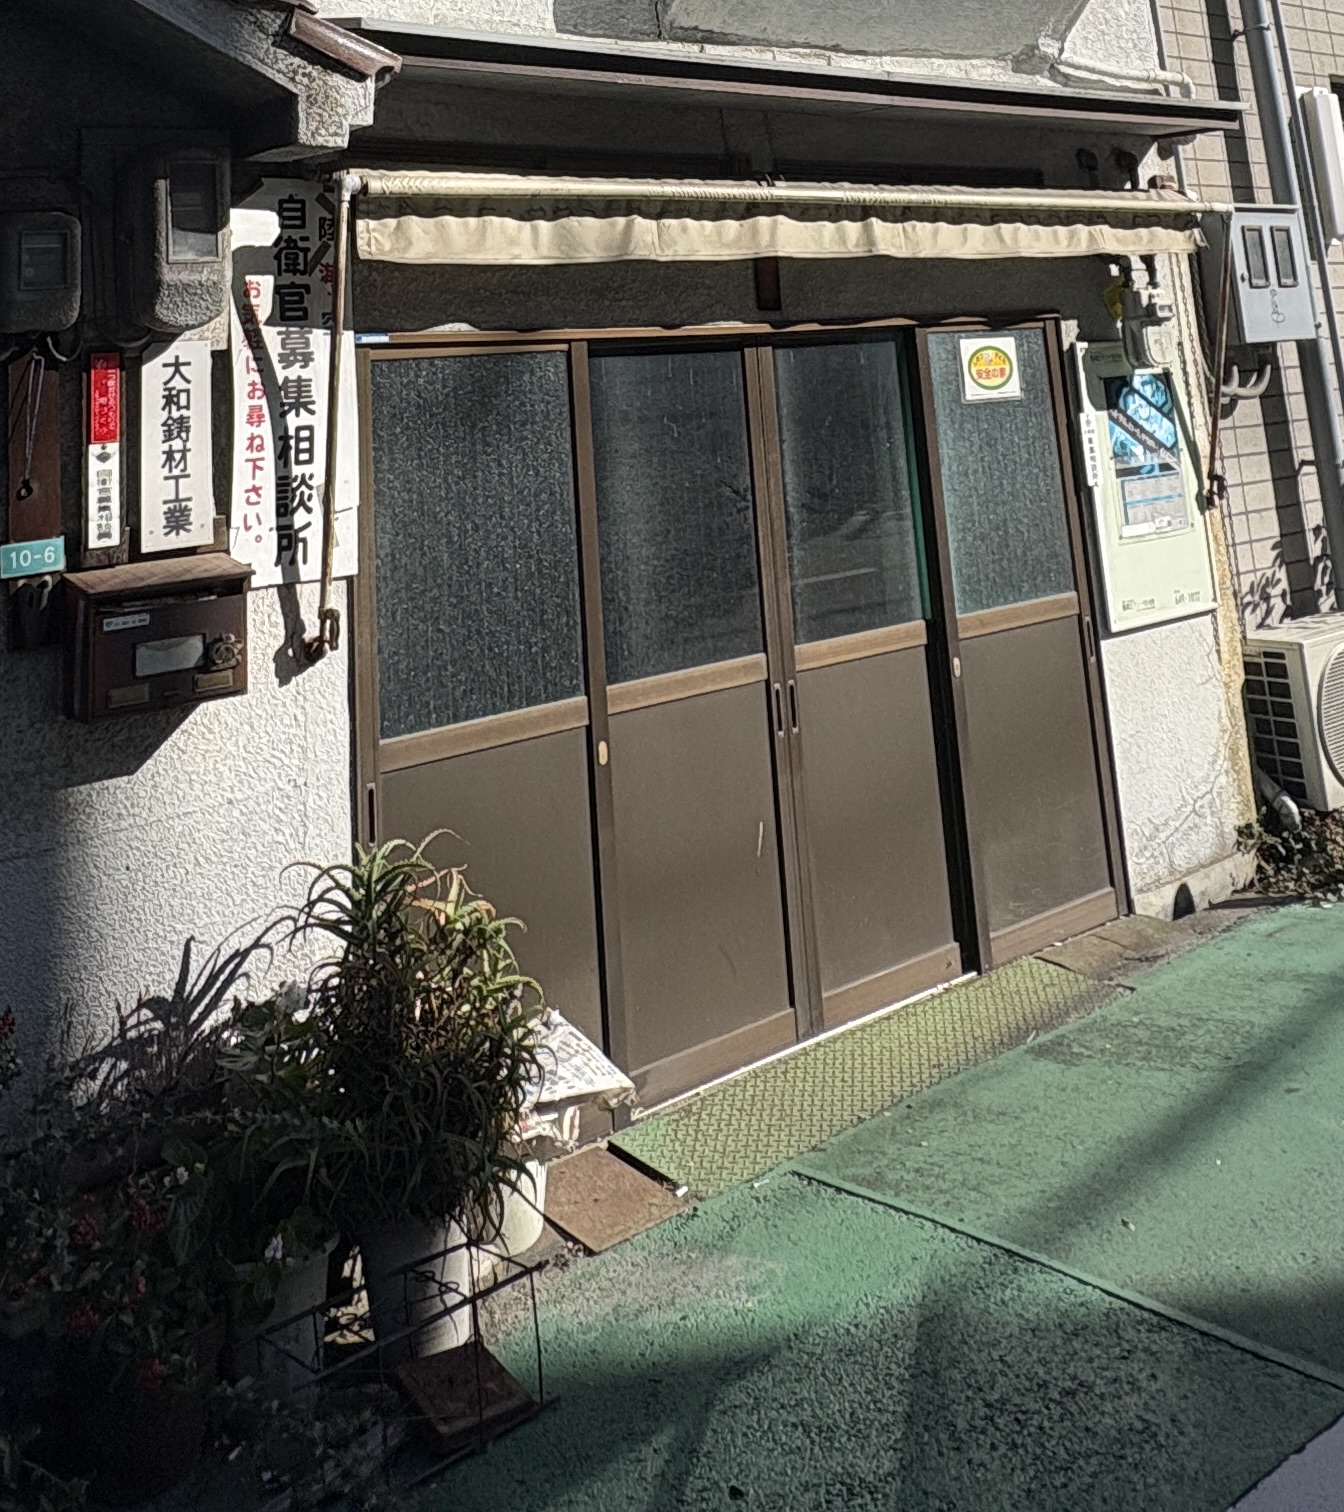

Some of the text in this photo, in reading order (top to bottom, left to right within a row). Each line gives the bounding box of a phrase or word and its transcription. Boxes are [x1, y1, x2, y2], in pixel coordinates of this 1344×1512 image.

[161, 355, 194, 536] 大和鋳材工業
[242, 279, 266, 543] お気軽にお尋ね下さい。
[270, 194, 317, 567] 自衛官募集相談所
[10, 545, 56, 569] 10-6
